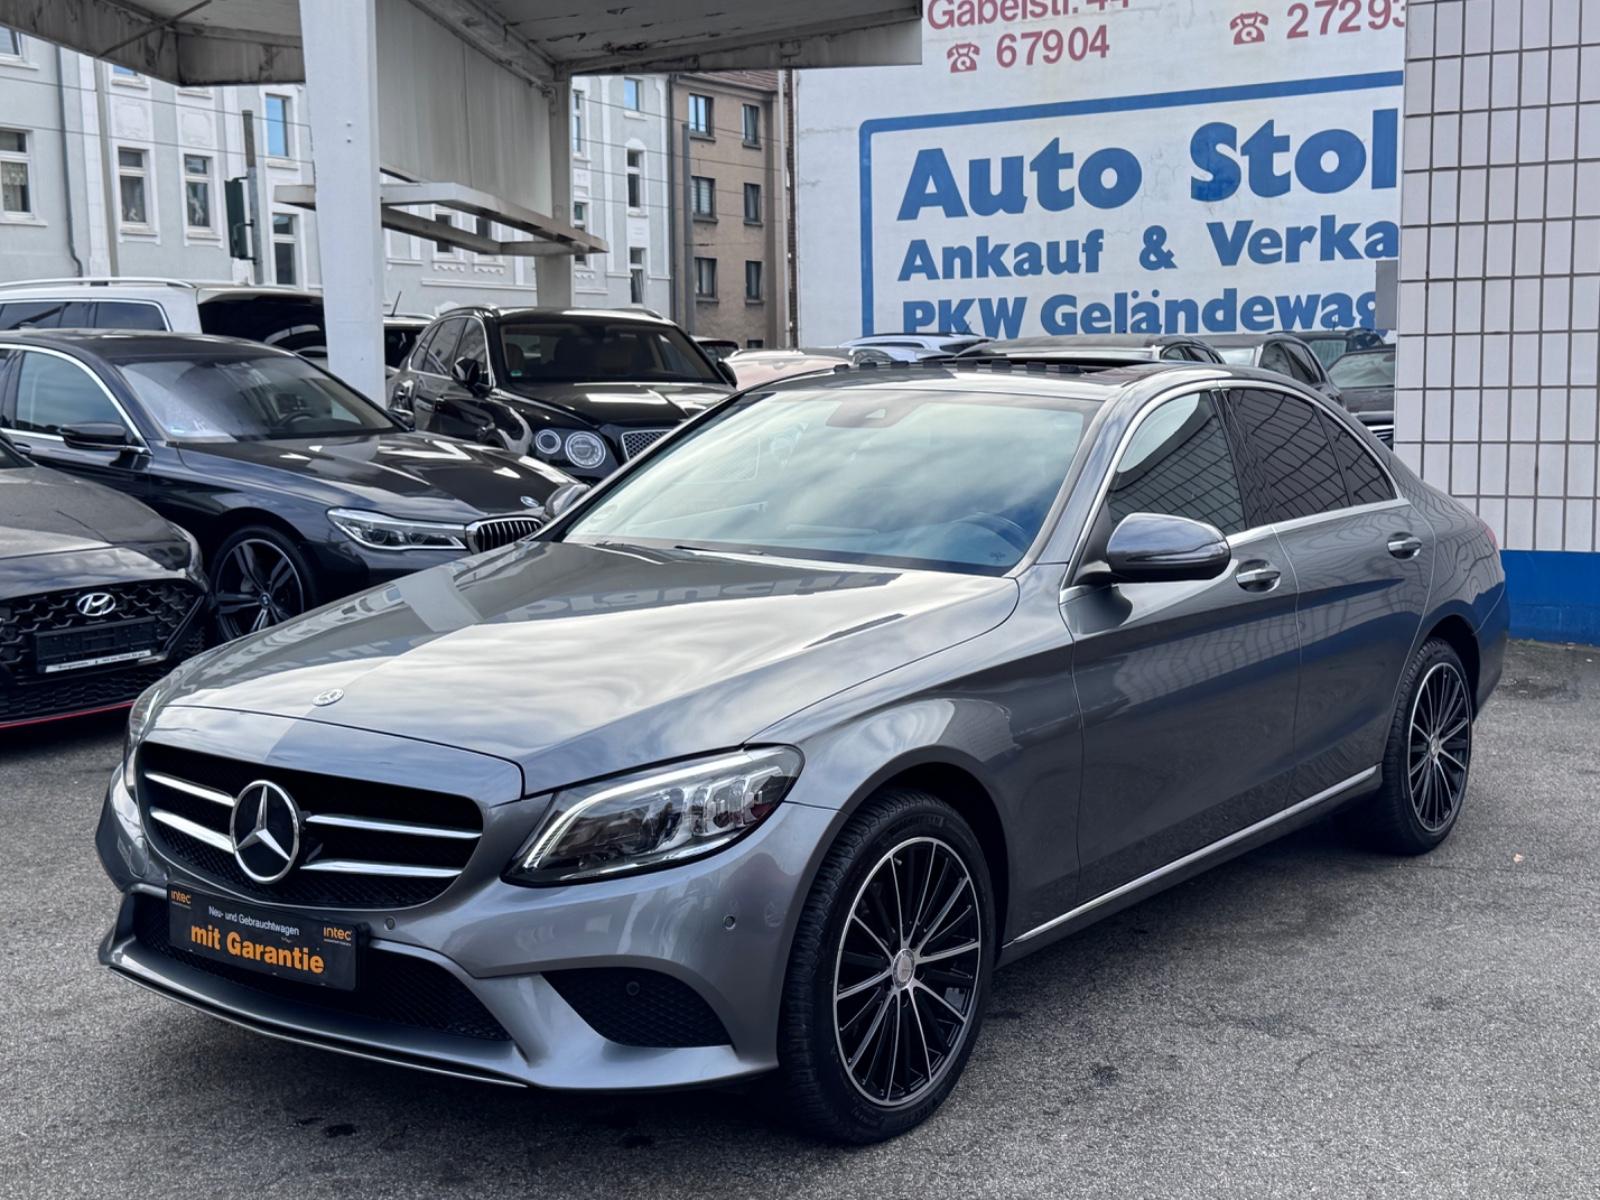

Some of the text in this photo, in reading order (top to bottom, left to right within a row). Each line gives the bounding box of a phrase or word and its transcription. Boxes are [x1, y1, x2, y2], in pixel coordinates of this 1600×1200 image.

[996, 24, 1110, 68] 67904
[897, 108, 1398, 221] Auto Stol
[897, 214, 1398, 281] Ankauf & Verka
[903, 296, 1028, 340] PKW
[208, 905, 300, 936] Neu- und Gebrauchtwagen
[323, 926, 352, 941] intec
[191, 924, 325, 974] mit Garantie
